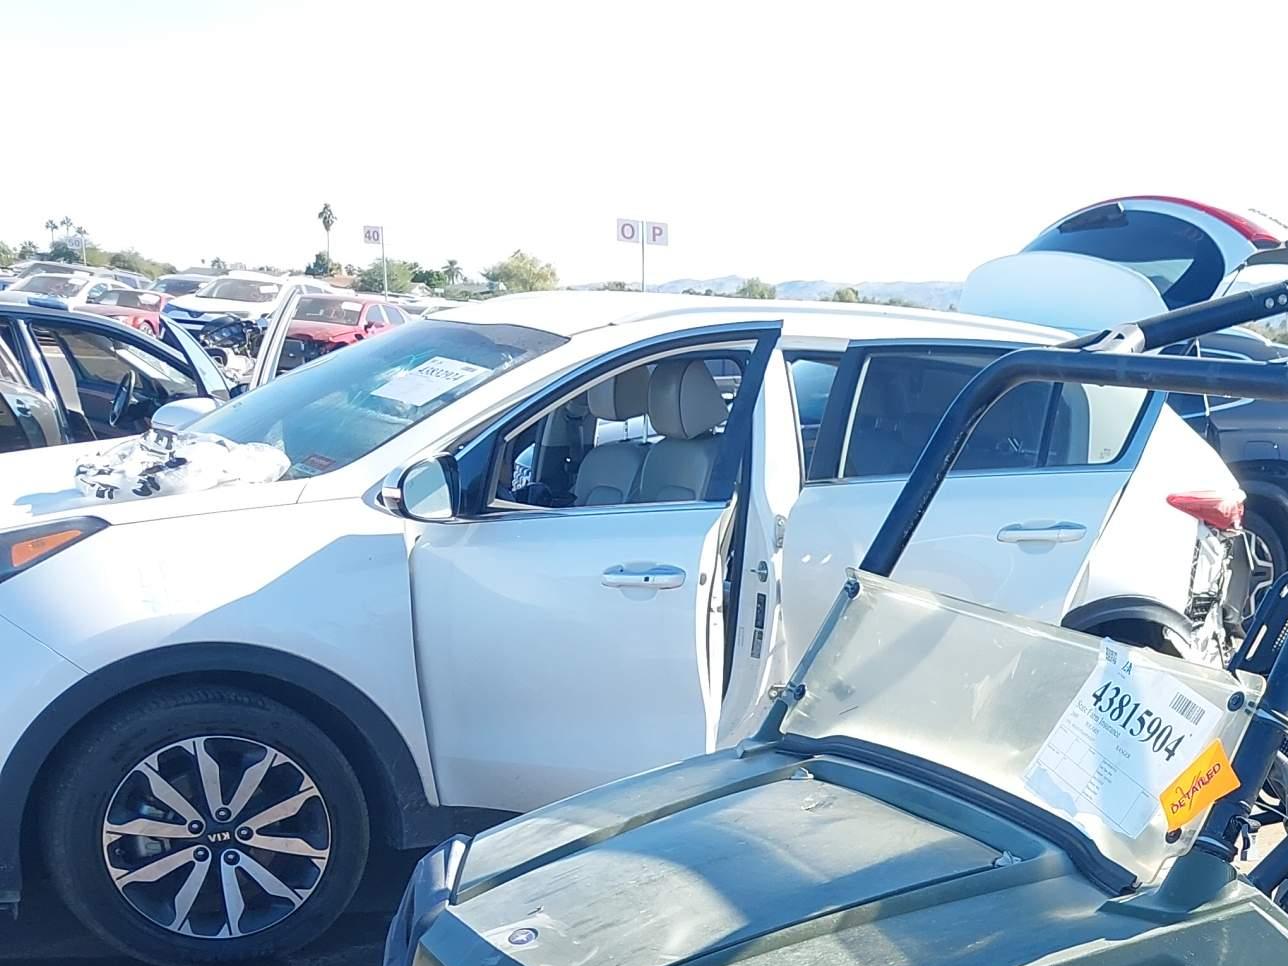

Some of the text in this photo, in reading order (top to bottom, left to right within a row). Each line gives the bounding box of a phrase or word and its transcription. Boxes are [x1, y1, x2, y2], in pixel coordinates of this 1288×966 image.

[364, 229, 380, 241] 40
[620, 223, 635, 240] O
[652, 226, 663, 242] P
[1092, 680, 1186, 762] 43815904
[1170, 763, 1222, 815] DETAILED
[207, 831, 231, 843] KIA
